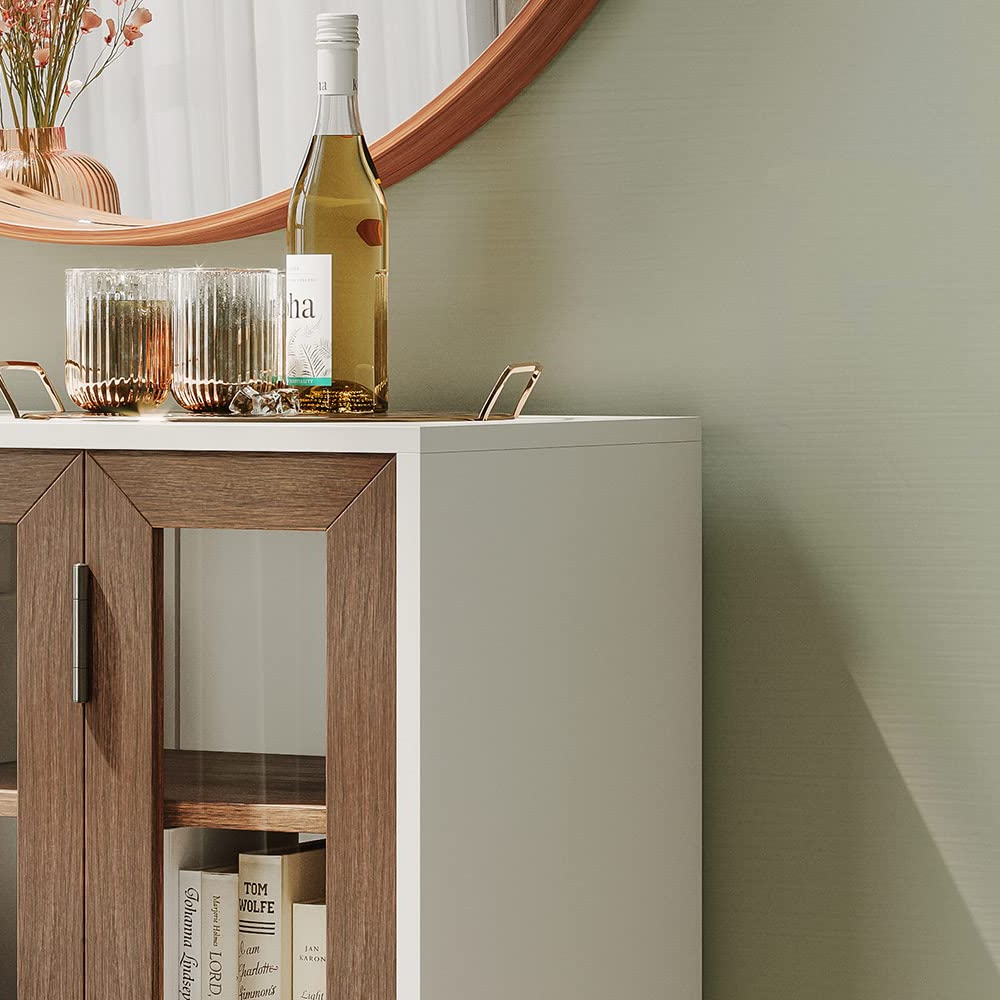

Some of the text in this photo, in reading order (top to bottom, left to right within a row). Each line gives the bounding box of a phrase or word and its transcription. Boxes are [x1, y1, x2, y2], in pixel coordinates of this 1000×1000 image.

[243, 881, 268, 896] TOM
[239, 898, 275, 914] WOLFE
[184, 887, 199, 947] Johanna
[298, 955, 327, 963] KARON
[208, 951, 222, 997] LORD,
